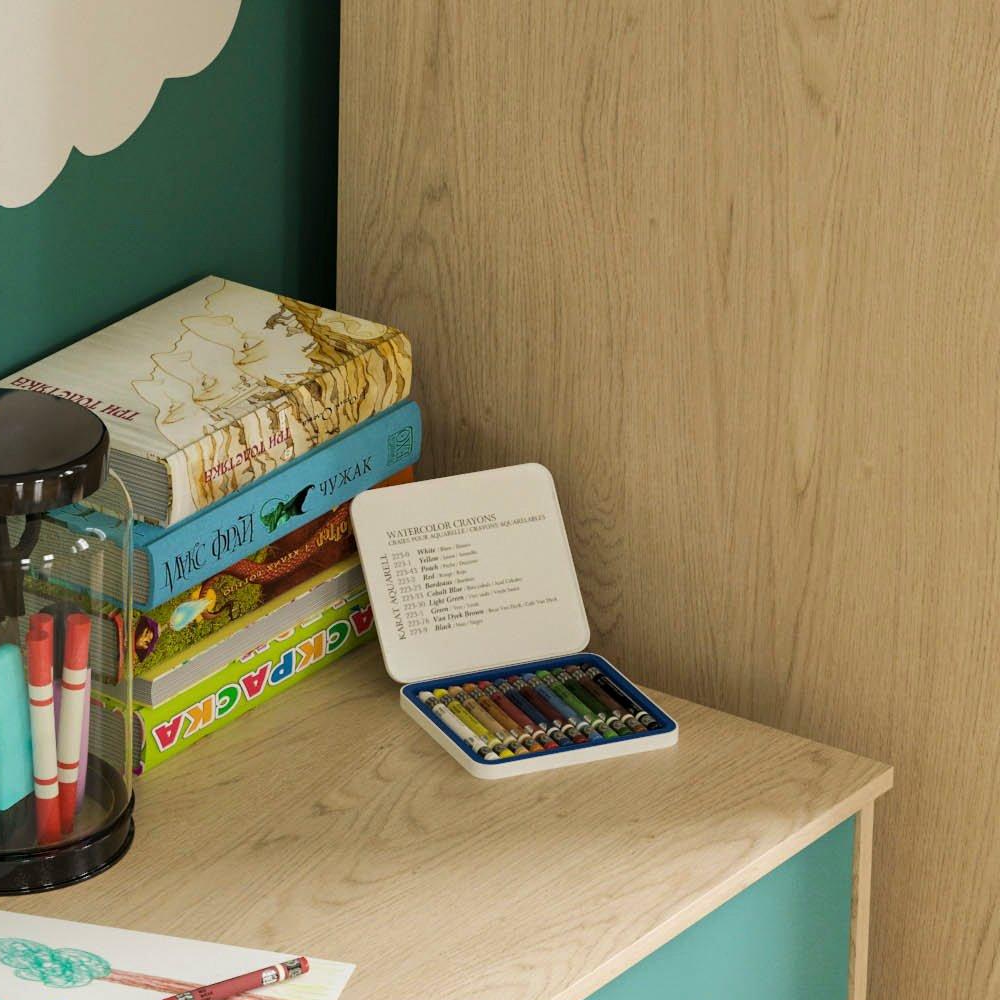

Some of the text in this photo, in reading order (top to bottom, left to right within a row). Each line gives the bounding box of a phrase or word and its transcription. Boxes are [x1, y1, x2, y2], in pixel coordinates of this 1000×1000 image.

[319, 456, 372, 496] ЧУЖАК
[386, 513, 497, 539] WATERCOLOR CRAYONS
[423, 573, 435, 581] Red
[380, 553, 406, 640] KARAT AQUARELL
[426, 589, 447, 597] Cobalt
[449, 586, 463, 594] Blue
[429, 598, 445, 607] Light
[446, 595, 464, 603] Green
[464, 609, 484, 617] Brown
[435, 623, 452, 631] Black
[152, 607, 377, 752] АСКРАСКА
